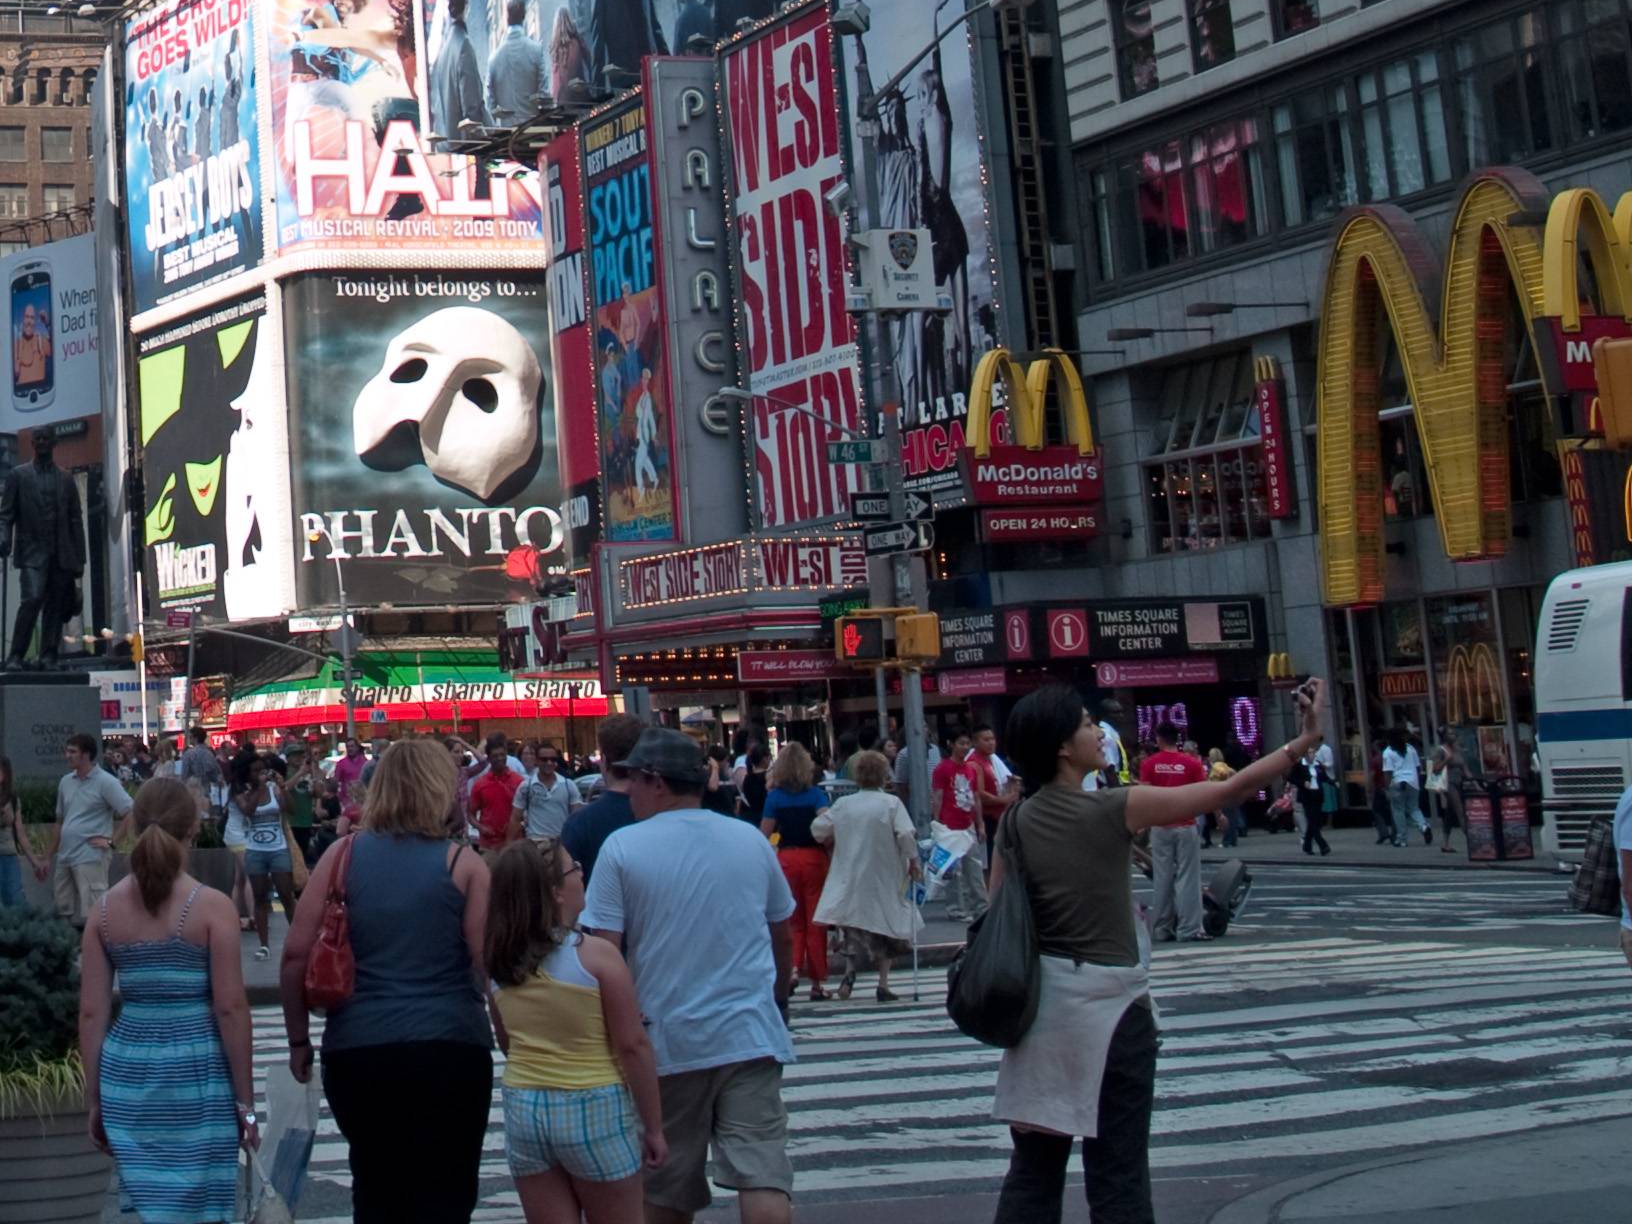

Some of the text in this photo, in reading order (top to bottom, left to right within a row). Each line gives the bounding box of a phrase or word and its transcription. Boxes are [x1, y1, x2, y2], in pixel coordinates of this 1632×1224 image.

[137, 29, 189, 80] GOES
[725, 6, 838, 199] WEST
[293, 119, 542, 218] HAIR
[207, 139, 253, 225] BOYS
[145, 160, 204, 252] JERSEY
[301, 219, 371, 238] MUSICAL
[378, 219, 441, 237] REVIVAL
[454, 219, 494, 237] 2009
[499, 220, 537, 238] TONY
[677, 86, 729, 436] PALACE
[735, 174, 857, 376] SIDE
[60, 287, 96, 310] When
[332, 274, 410, 303] Tonight
[415, 274, 491, 303] belongs
[61, 311, 86, 333] Dad
[62, 339, 85, 362] you
[918, 382, 1004, 425] LARE
[828, 445, 840, 461] W
[841, 444, 856, 461] 46
[898, 409, 1008, 477] HICAO
[1261, 388, 1281, 511] OPEN 24 HOURS
[977, 463, 1098, 483] McDonald's
[997, 483, 1078, 496] Restaurant
[862, 500, 917, 514] ONE AY
[300, 505, 565, 562] PHANTO
[990, 516, 1096, 530] OPEN 24 HORS
[871, 529, 915, 547] ONE WAY
[628, 546, 741, 604] WEST SIDE STORY
[763, 543, 838, 586] WEST
[841, 541, 866, 584] SIDE
[940, 614, 994, 633] TIMES SQUARE
[1096, 608, 1179, 623] TIMES SQUARE
[942, 630, 994, 648] INFORMATION
[1100, 623, 1179, 637] INFORMATION
[954, 649, 984, 664] CENTER
[1119, 637, 1162, 651] CENTER
[339, 683, 412, 705] sbarro
[432, 679, 505, 702] sbarro
[524, 678, 596, 700] sbarro
